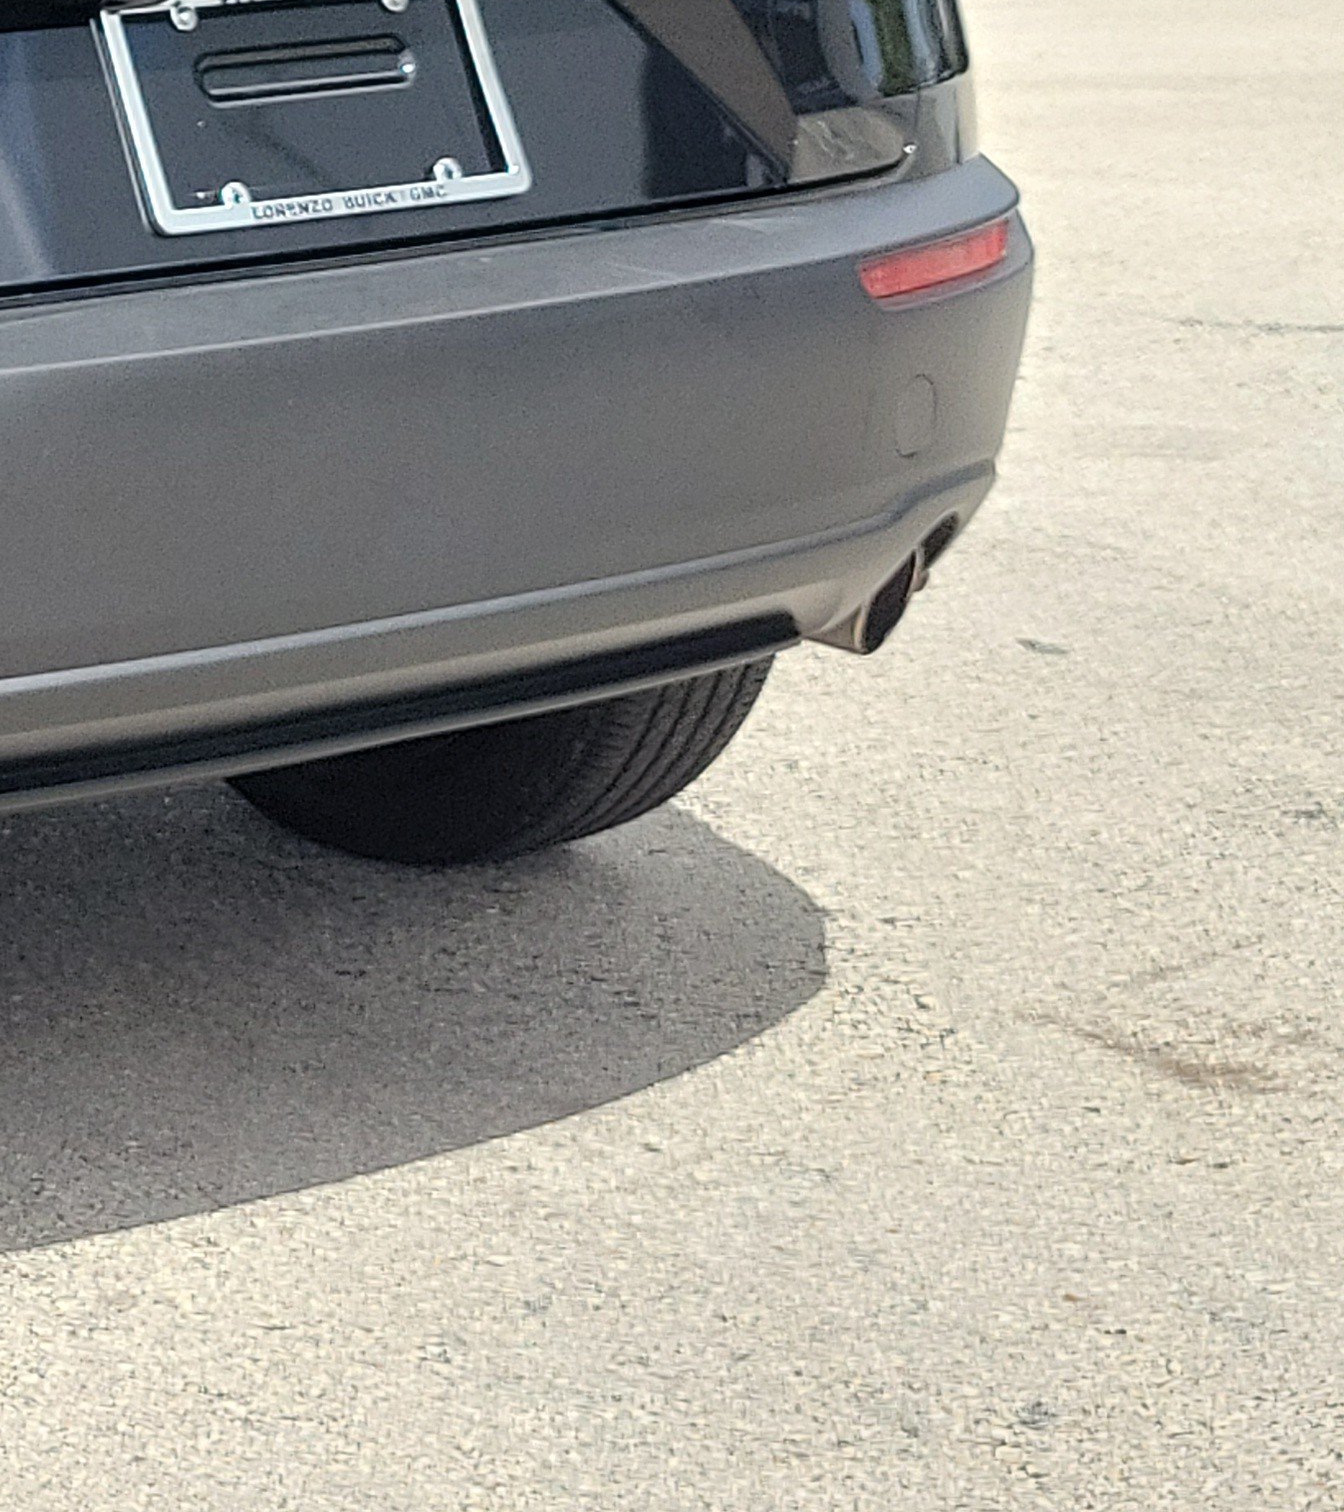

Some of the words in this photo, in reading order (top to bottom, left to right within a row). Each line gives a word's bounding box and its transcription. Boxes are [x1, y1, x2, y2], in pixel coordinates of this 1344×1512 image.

[251, 197, 334, 221] LORENZO
[342, 191, 398, 211] BUICK
[409, 183, 449, 202] GMC
